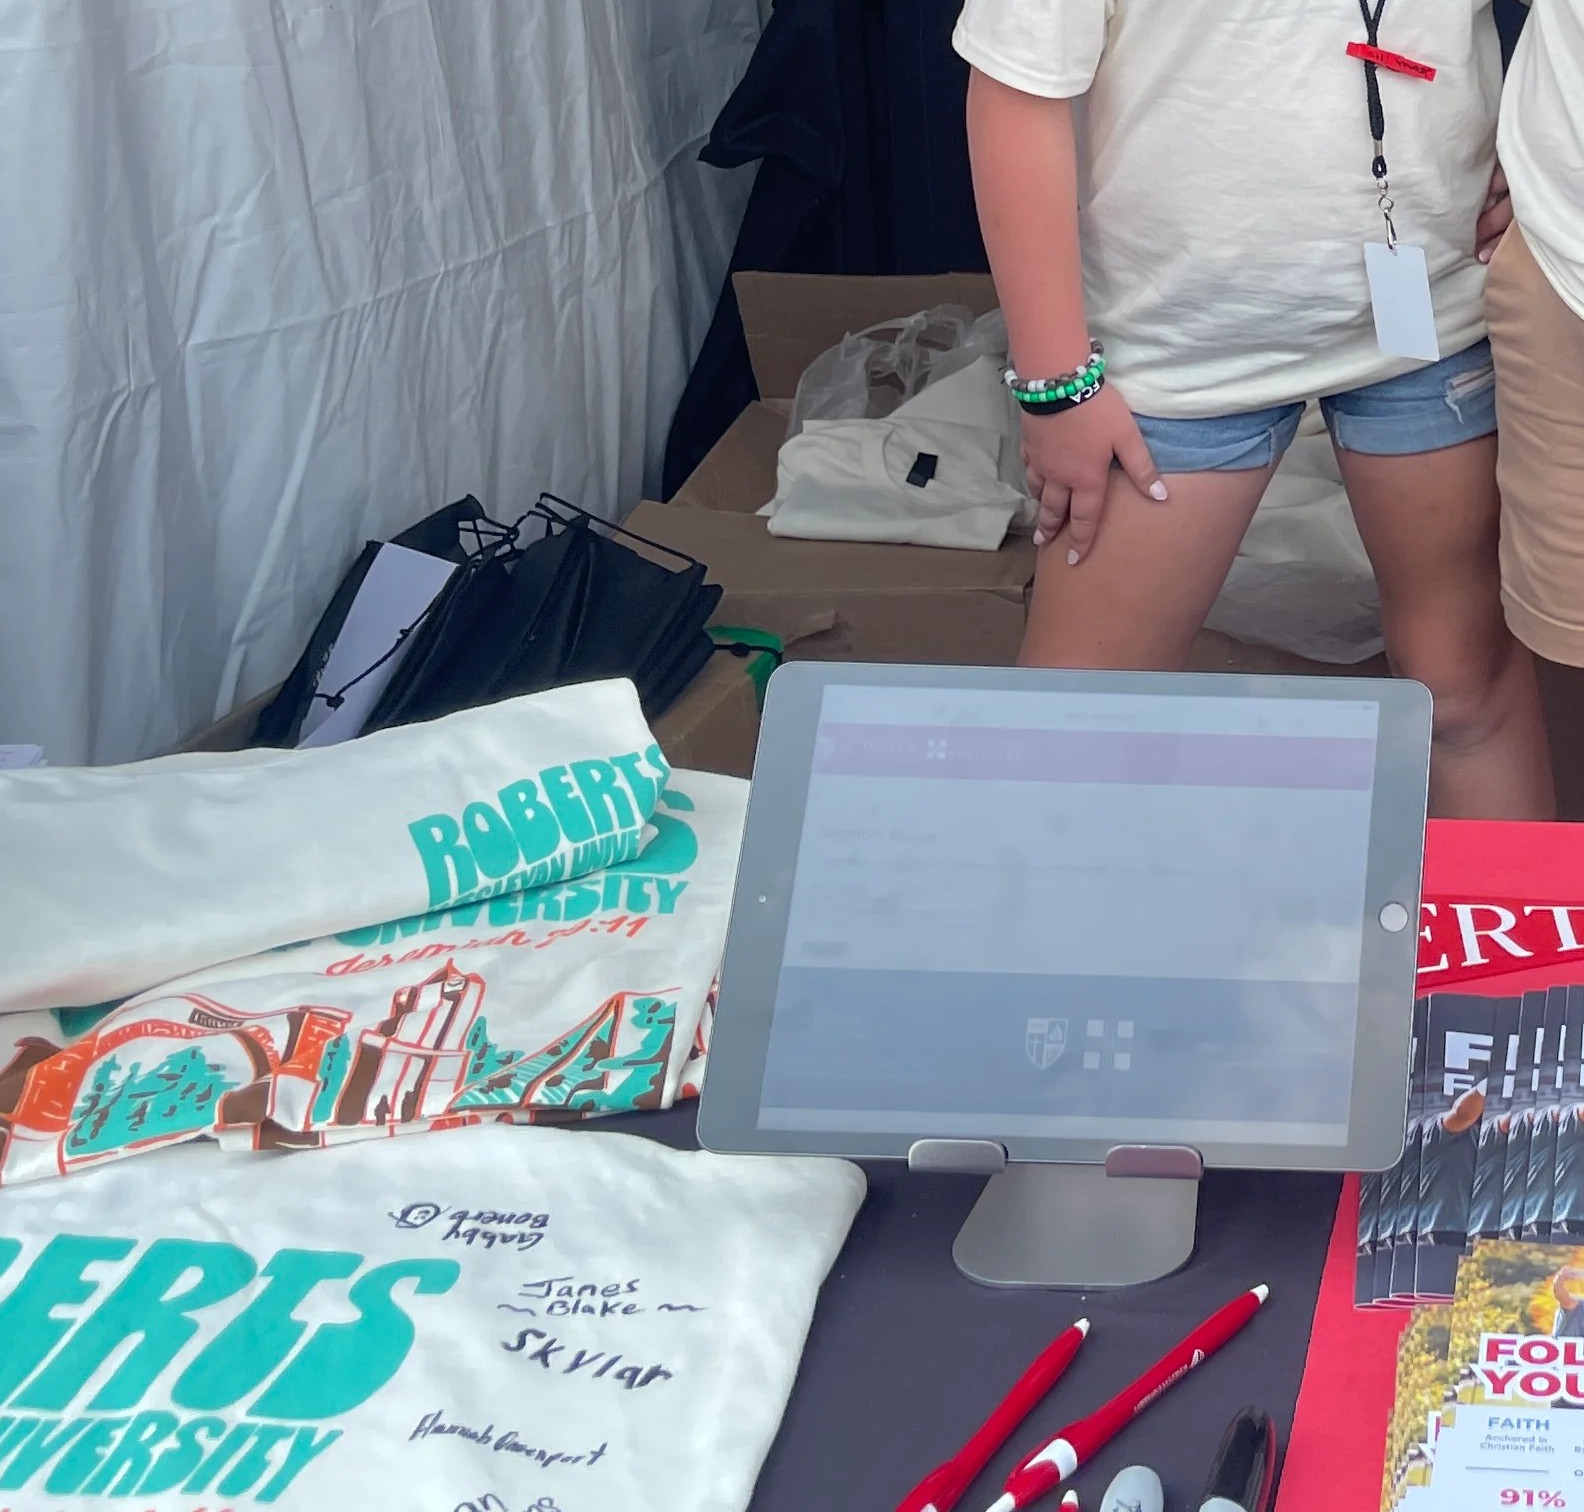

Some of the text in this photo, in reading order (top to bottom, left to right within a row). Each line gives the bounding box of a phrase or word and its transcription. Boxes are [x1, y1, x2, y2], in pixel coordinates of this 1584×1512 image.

[408, 743, 671, 913] ROBERTS
[573, 828, 640, 875] UNIVE
[332, 873, 690, 948] IVERSITY
[0, 1233, 461, 1421] ERTS
[546, 1300, 645, 1318] Blake
[1487, 1416, 1550, 1431] FAITH
[0, 1409, 344, 1505] IVERSITY
[1479, 1441, 1555, 1454] Christian Faith
[1499, 1487, 1566, 1508] 91%
